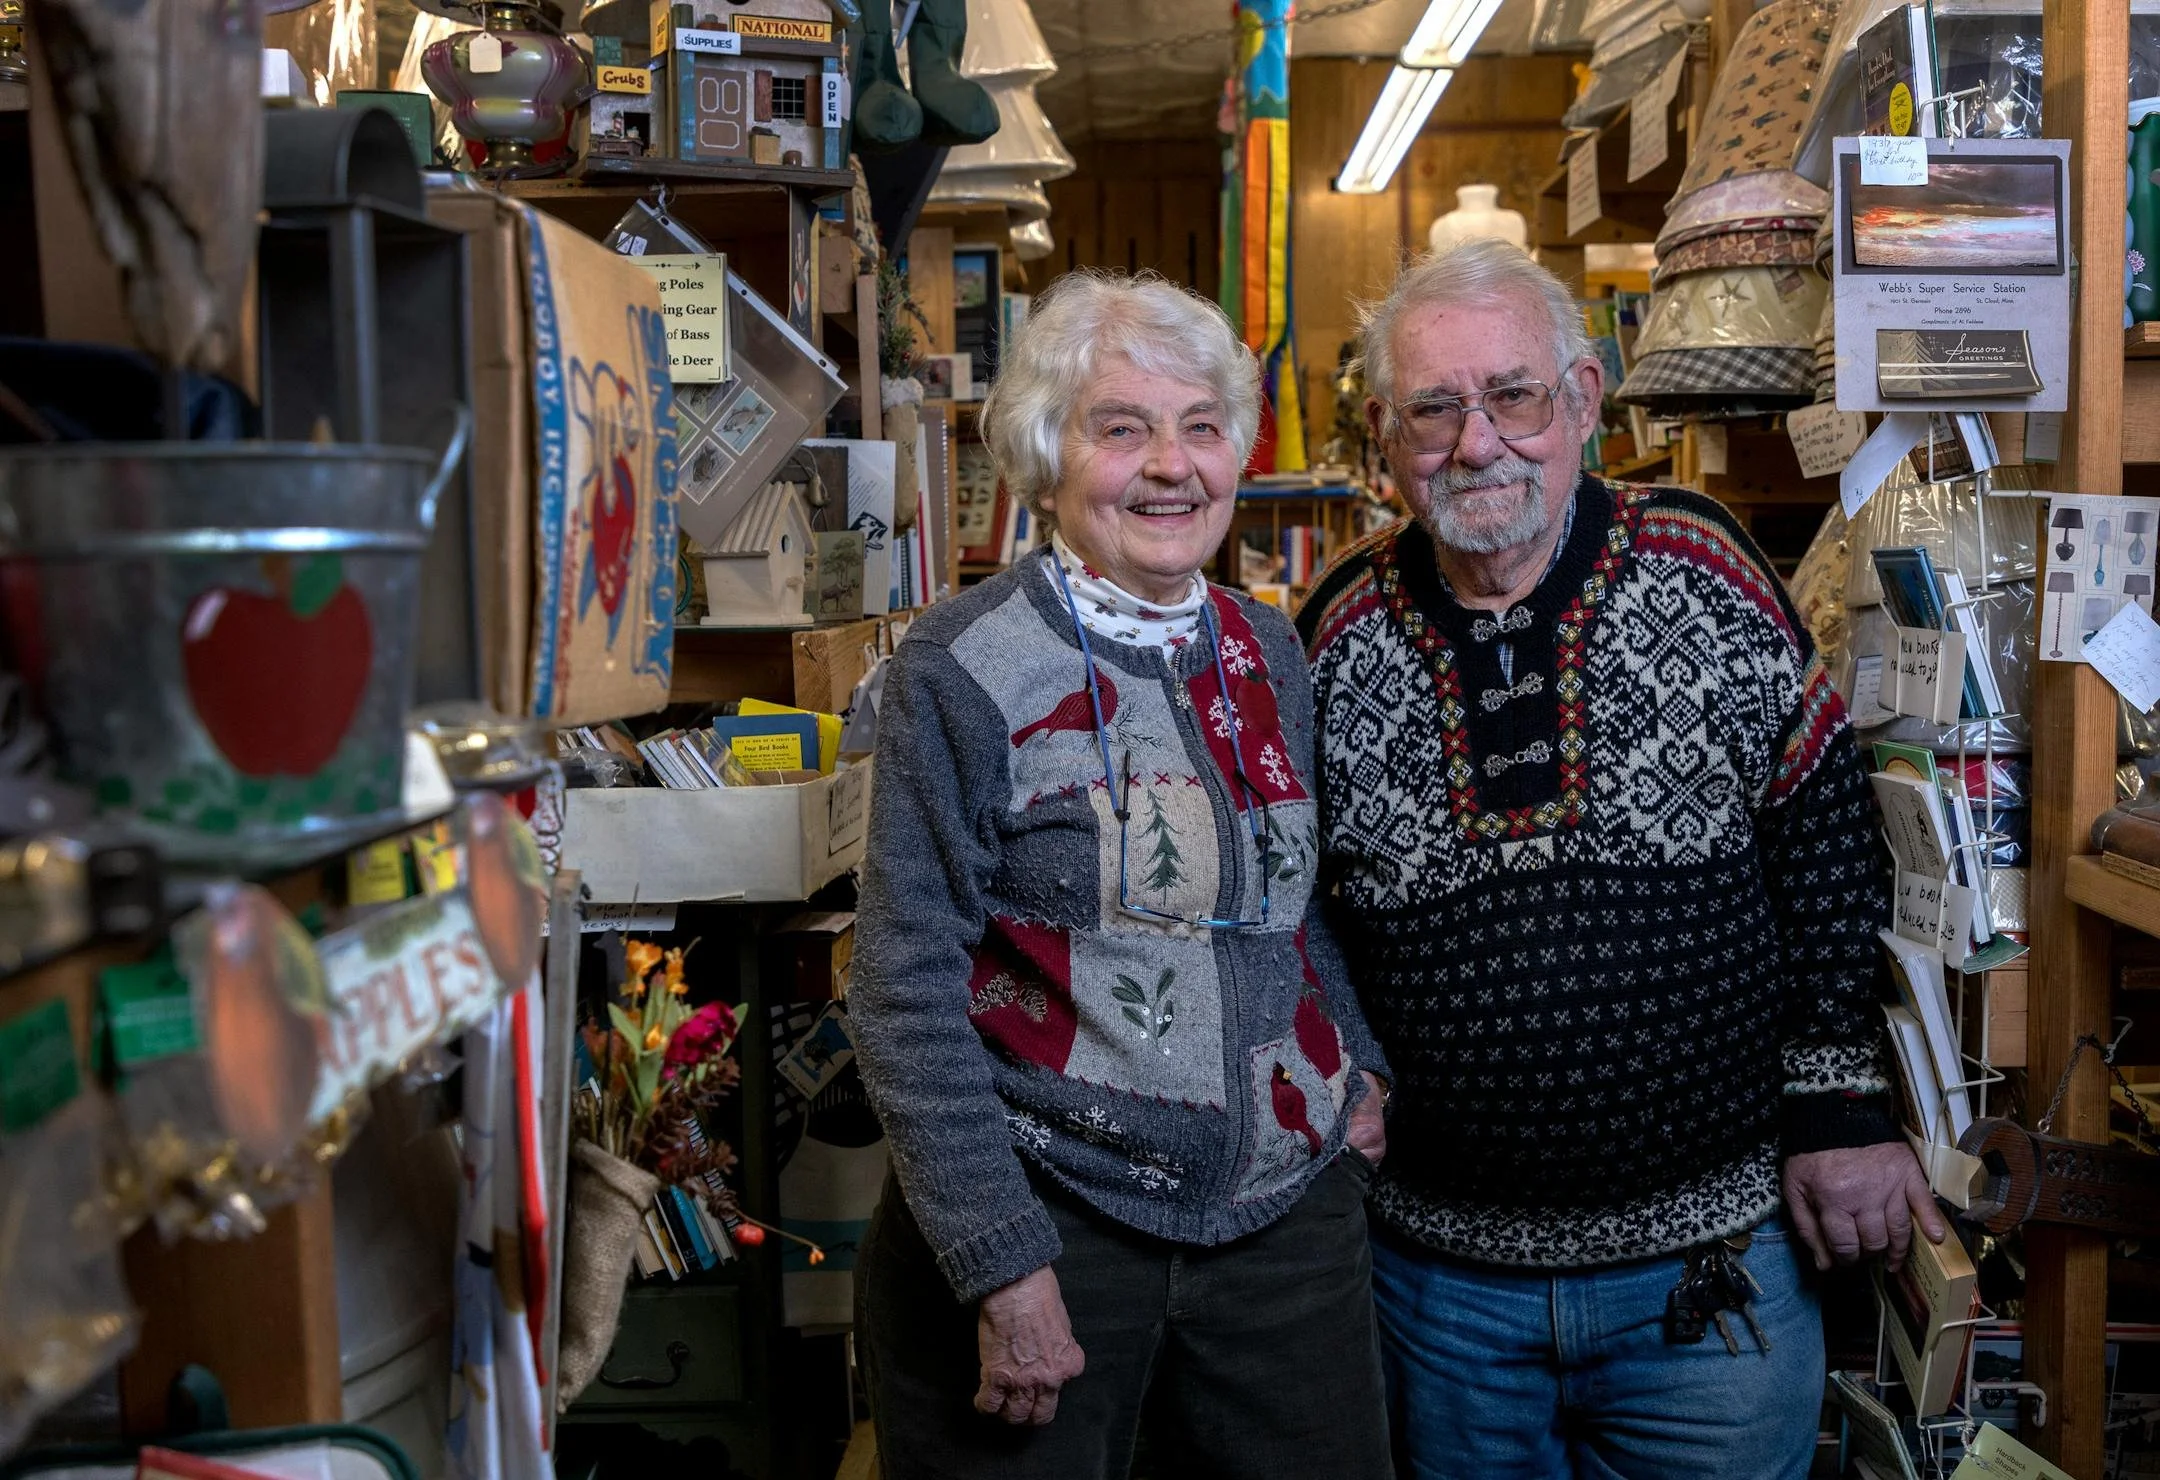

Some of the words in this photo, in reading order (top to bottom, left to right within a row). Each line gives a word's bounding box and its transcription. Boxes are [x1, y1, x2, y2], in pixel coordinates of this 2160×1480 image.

[741, 19, 824, 38] NATIONAL
[684, 33, 733, 49] SUPPLIES
[603, 71, 645, 89] Grubs
[827, 80, 837, 122] OPEN
[658, 280, 667, 292] g
[670, 278, 704, 290] Poles
[1879, 282, 1912, 294] Webb's
[1919, 282, 1945, 296] Super
[1953, 282, 1985, 294] Service
[1993, 282, 2026, 294] Station
[663, 304, 683, 318] ing
[686, 304, 717, 315] Gear
[681, 328, 710, 340] Bass
[1945, 333, 2006, 367] Season's
[668, 355, 680, 366] le
[683, 356, 713, 367] Deer
[1916, 634, 1940, 656] books
[1890, 659, 1918, 677] reuced
[1897, 904, 1927, 934] educed
[1929, 919, 1937, 933] to
[312, 931, 483, 1072] APPLES
[1994, 1456, 2019, 1477] Shapes
[1995, 1447, 2027, 1472] Hardback
